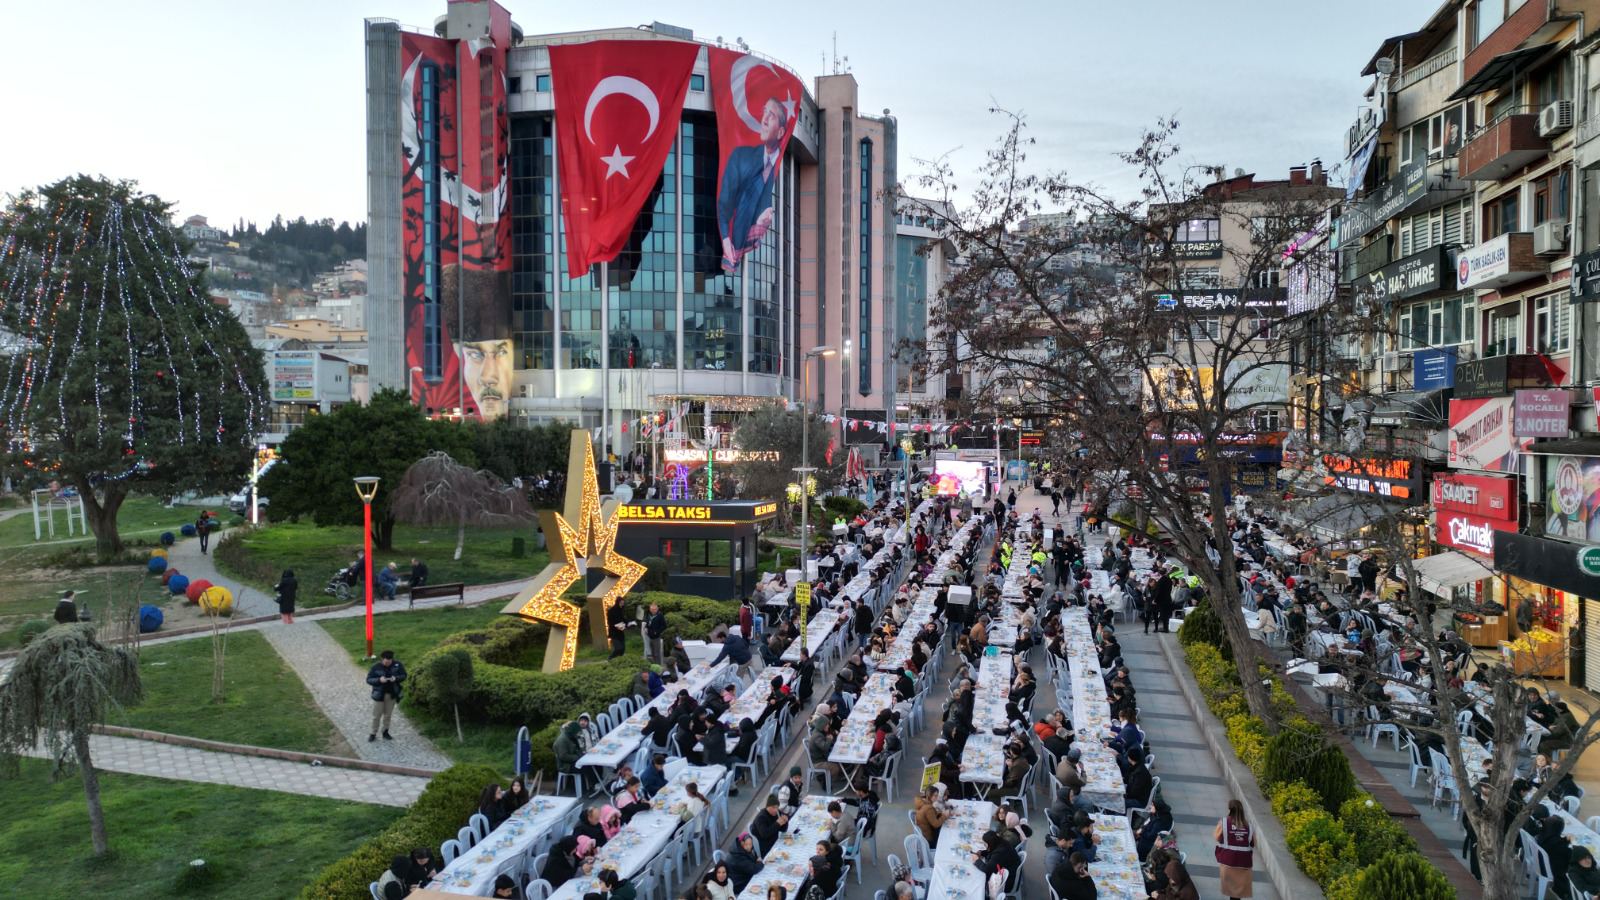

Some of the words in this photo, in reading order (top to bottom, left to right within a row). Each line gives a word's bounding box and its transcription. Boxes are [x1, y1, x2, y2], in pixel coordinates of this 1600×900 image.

[1533, 394, 1551, 402] T.C.
[1516, 418, 1567, 432] 3.NOTER
[1443, 483, 1479, 504] SAADET
[619, 506, 665, 518] BELSA
[754, 504, 766, 516] BELSA
